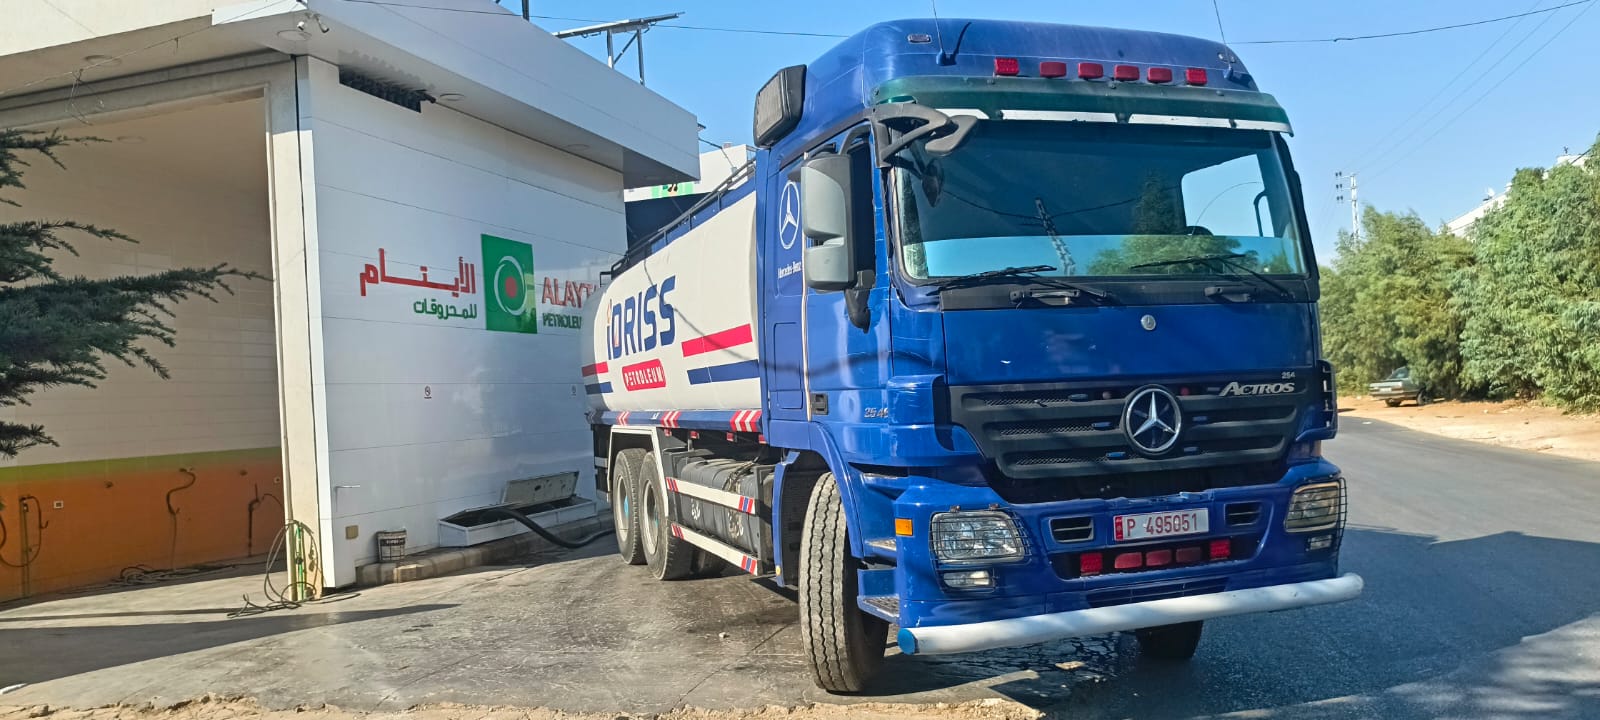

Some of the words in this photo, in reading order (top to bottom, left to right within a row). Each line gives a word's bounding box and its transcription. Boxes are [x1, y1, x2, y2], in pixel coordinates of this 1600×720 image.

[360, 248, 477, 298] الأيتام
[542, 276, 597, 309] ALAYT
[413, 298, 477, 320] للمحروقات
[542, 312, 582, 330] PETROLEU
[624, 365, 664, 387] PETROLEUM
[1126, 518, 1136, 537] P
[1146, 513, 1198, 535] 495051
